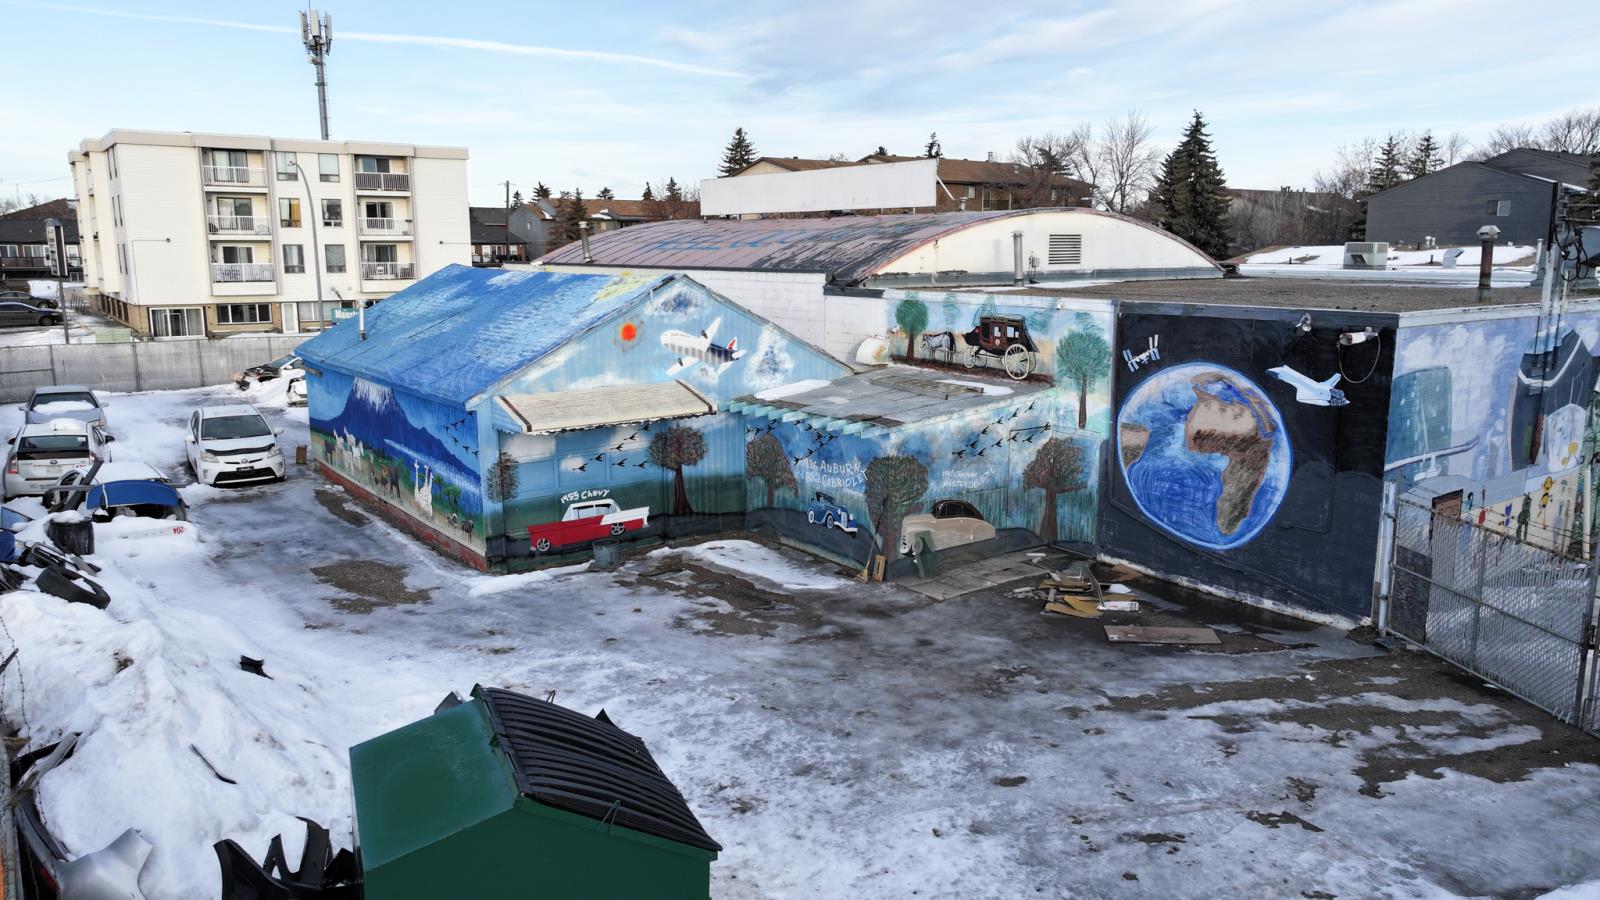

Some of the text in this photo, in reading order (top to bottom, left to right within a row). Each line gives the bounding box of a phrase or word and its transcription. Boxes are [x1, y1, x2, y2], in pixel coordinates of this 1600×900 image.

[820, 459, 861, 475] AUBURN
[560, 489, 609, 504] 1955 Chevy
